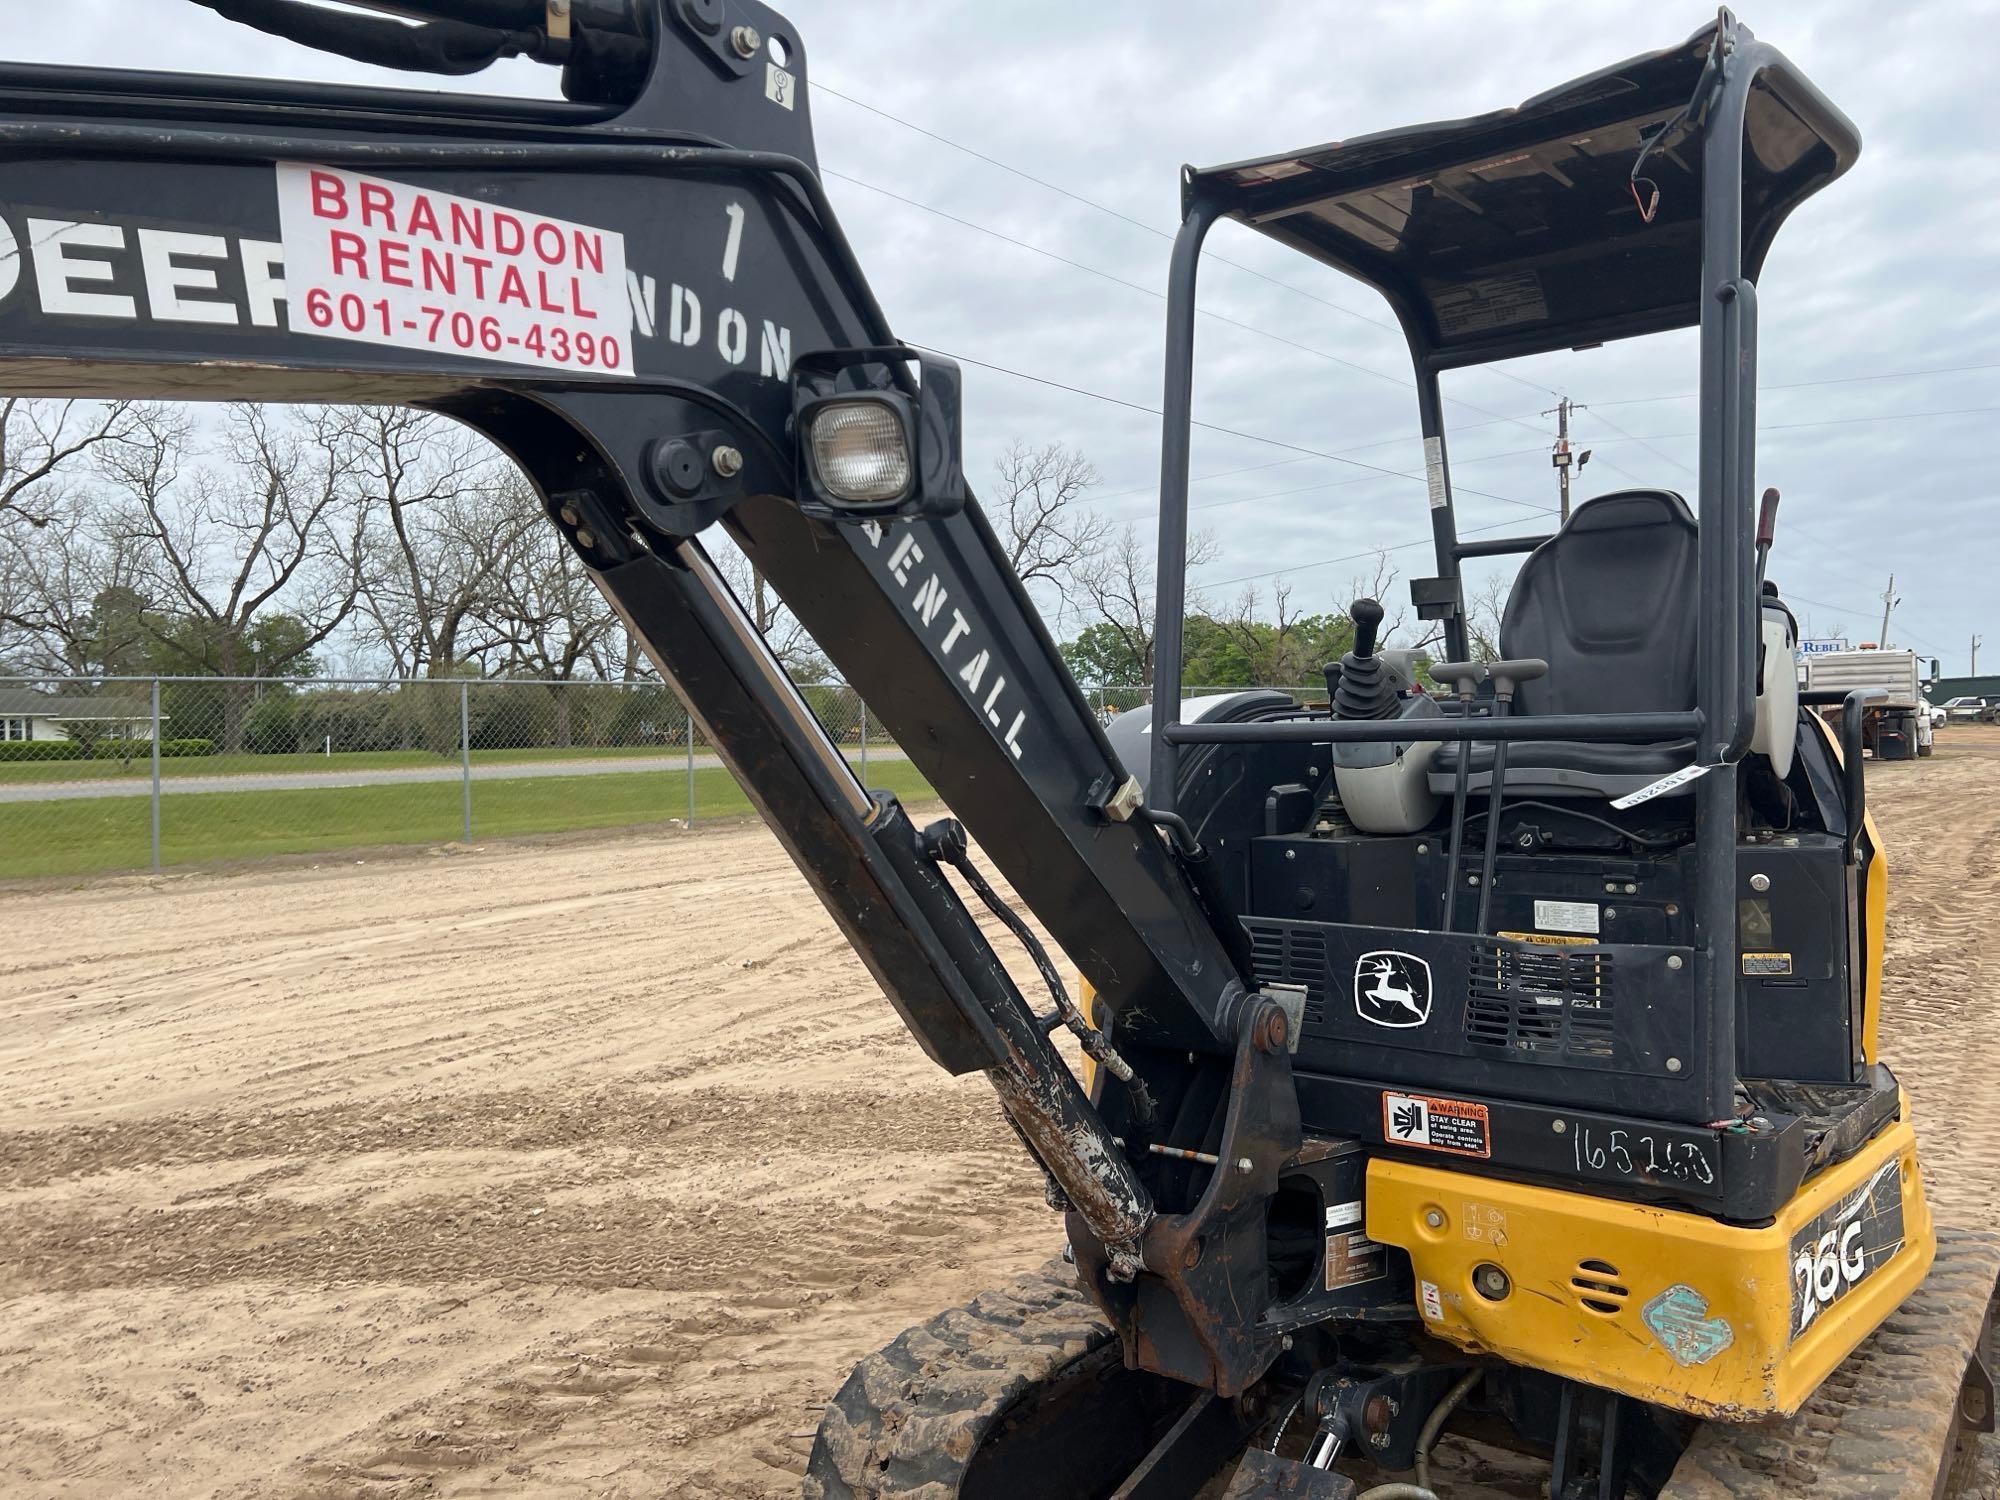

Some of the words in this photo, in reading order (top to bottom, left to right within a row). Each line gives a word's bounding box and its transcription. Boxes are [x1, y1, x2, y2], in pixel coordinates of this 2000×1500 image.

[310, 170, 604, 274] BRANDON
[722, 202, 745, 282] 1
[330, 229, 598, 320] RENTALL
[306, 288, 620, 369] 601-706-4390
[1535, 936, 1567, 944] CAUTION
[1430, 1115, 1448, 1124] STAY
[1452, 1118, 1476, 1127] CLEAR
[1439, 1104, 1484, 1117] WARNING
[1431, 1130, 1454, 1140] Operate
[1447, 1139, 1461, 1147] from
[1794, 1221, 1865, 1337] 26G
